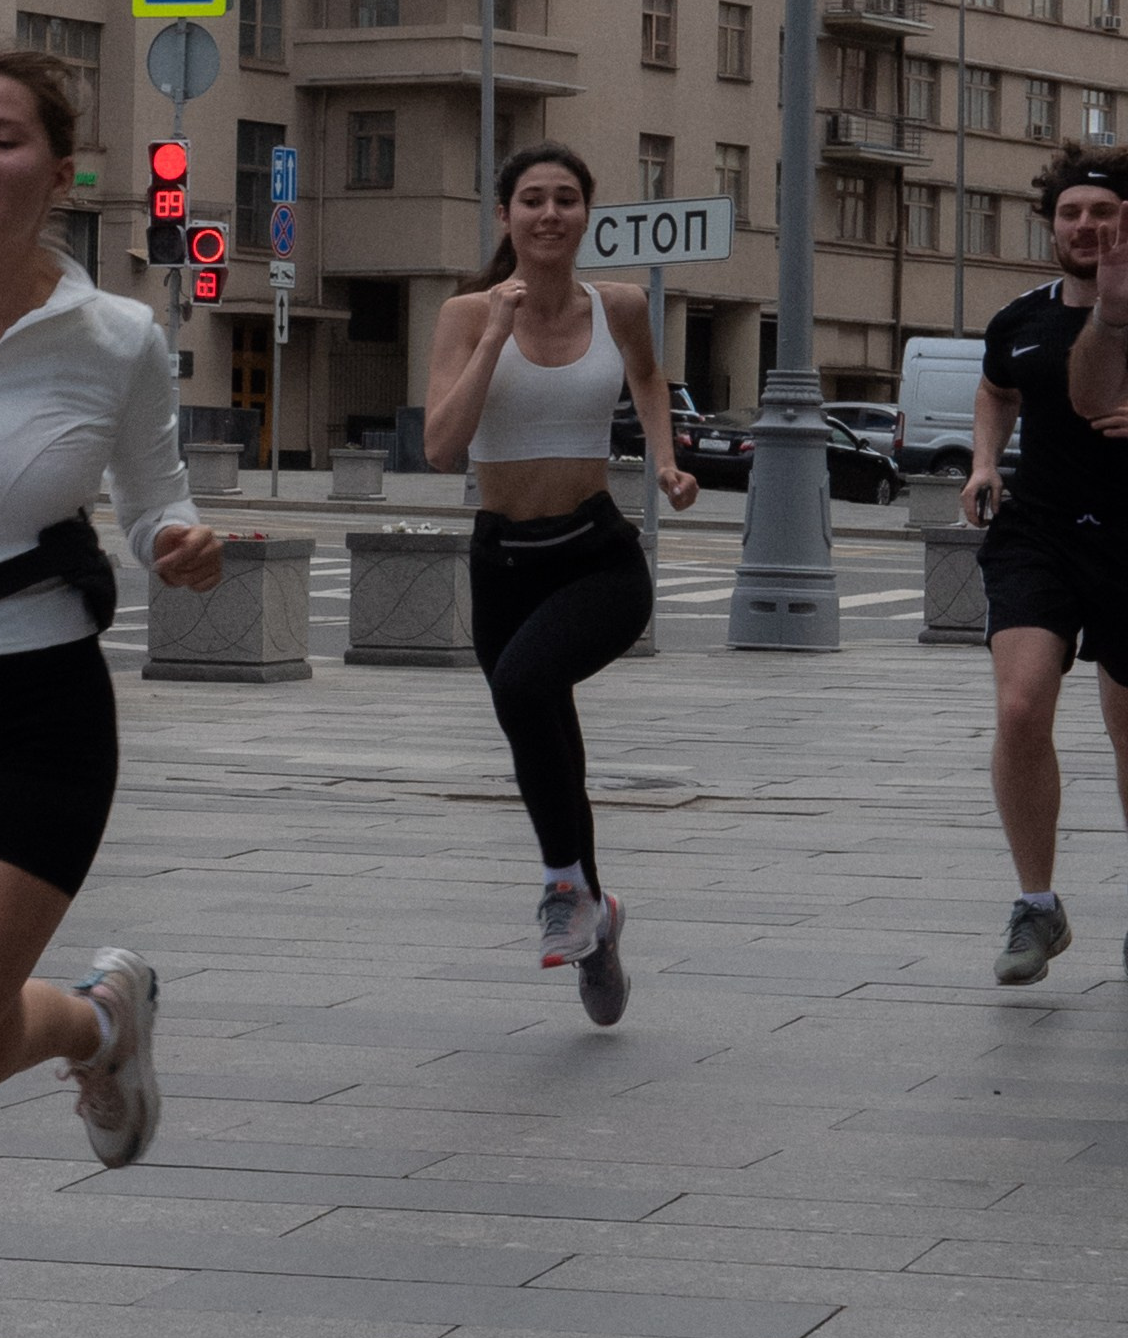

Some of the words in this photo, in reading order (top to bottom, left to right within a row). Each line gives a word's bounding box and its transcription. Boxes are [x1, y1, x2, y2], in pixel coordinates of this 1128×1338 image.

[155, 191, 184, 217] 89
[595, 210, 708, 258] СТОП
[196, 272, 216, 298] 63
